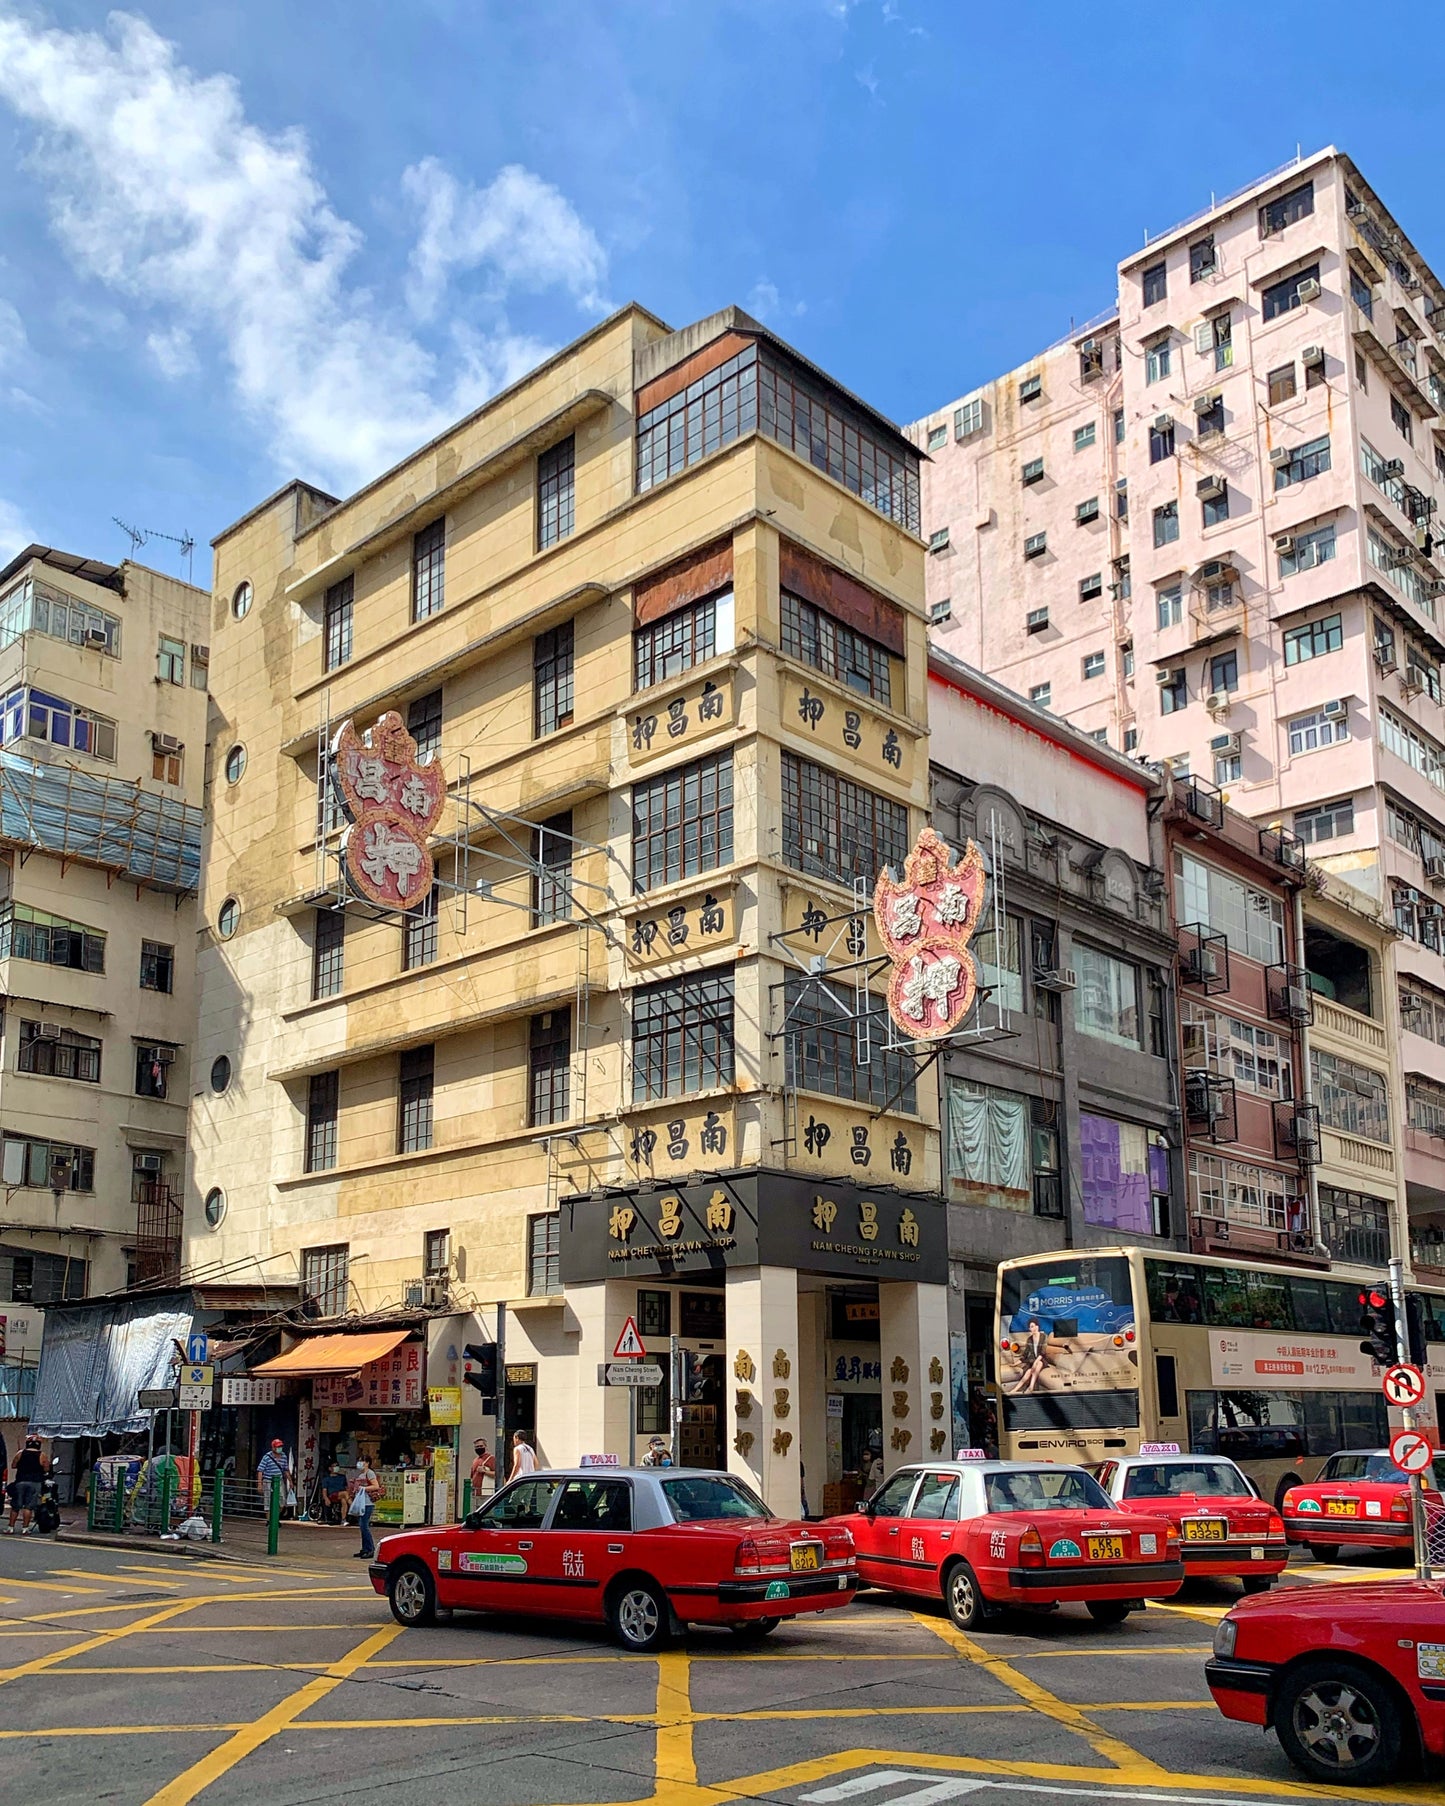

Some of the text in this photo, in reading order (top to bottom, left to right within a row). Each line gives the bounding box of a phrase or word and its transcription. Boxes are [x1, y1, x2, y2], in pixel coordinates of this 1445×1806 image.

[360, 822, 423, 898] 押
[901, 955, 961, 1021] 押
[608, 1248, 628, 1259] NAM
[630, 1243, 671, 1257] CHEONG
[672, 1240, 702, 1253] PAWN
[705, 1236, 733, 1248] SHOP
[812, 1240, 921, 1263] NAM CHEONG PAWN SHOP
[1040, 1295, 1073, 1306] MORRIS
[625, 1366, 643, 1374] Cheong
[200, 1387, 206, 1395] 7
[199, 1400, 210, 1408] 12
[733, 1348, 755, 1457] 南昌押
[772, 1348, 793, 1457] 南昌押
[890, 1355, 912, 1454] 南昌押
[928, 1356, 946, 1455] 南昌押
[1143, 1444, 1177, 1452] TAXI
[589, 1454, 617, 1464] TAXI
[963, 1450, 984, 1458] TAXI
[1329, 1506, 1355, 1514] 5747
[1196, 1521, 1211, 1531] KY
[990, 1530, 1007, 1546] 的士
[1190, 1530, 1220, 1539] 3329
[911, 1536, 924, 1550] 的士
[1098, 1538, 1112, 1548] KR
[797, 1547, 808, 1558] FP
[912, 1549, 925, 1560] TAXI
[990, 1545, 1006, 1559] TAXI
[1062, 1545, 1068, 1553] 5
[1091, 1547, 1121, 1558] 8738
[562, 1549, 584, 1563] 的士
[794, 1557, 815, 1569] 8212
[563, 1563, 584, 1577] TAXI
